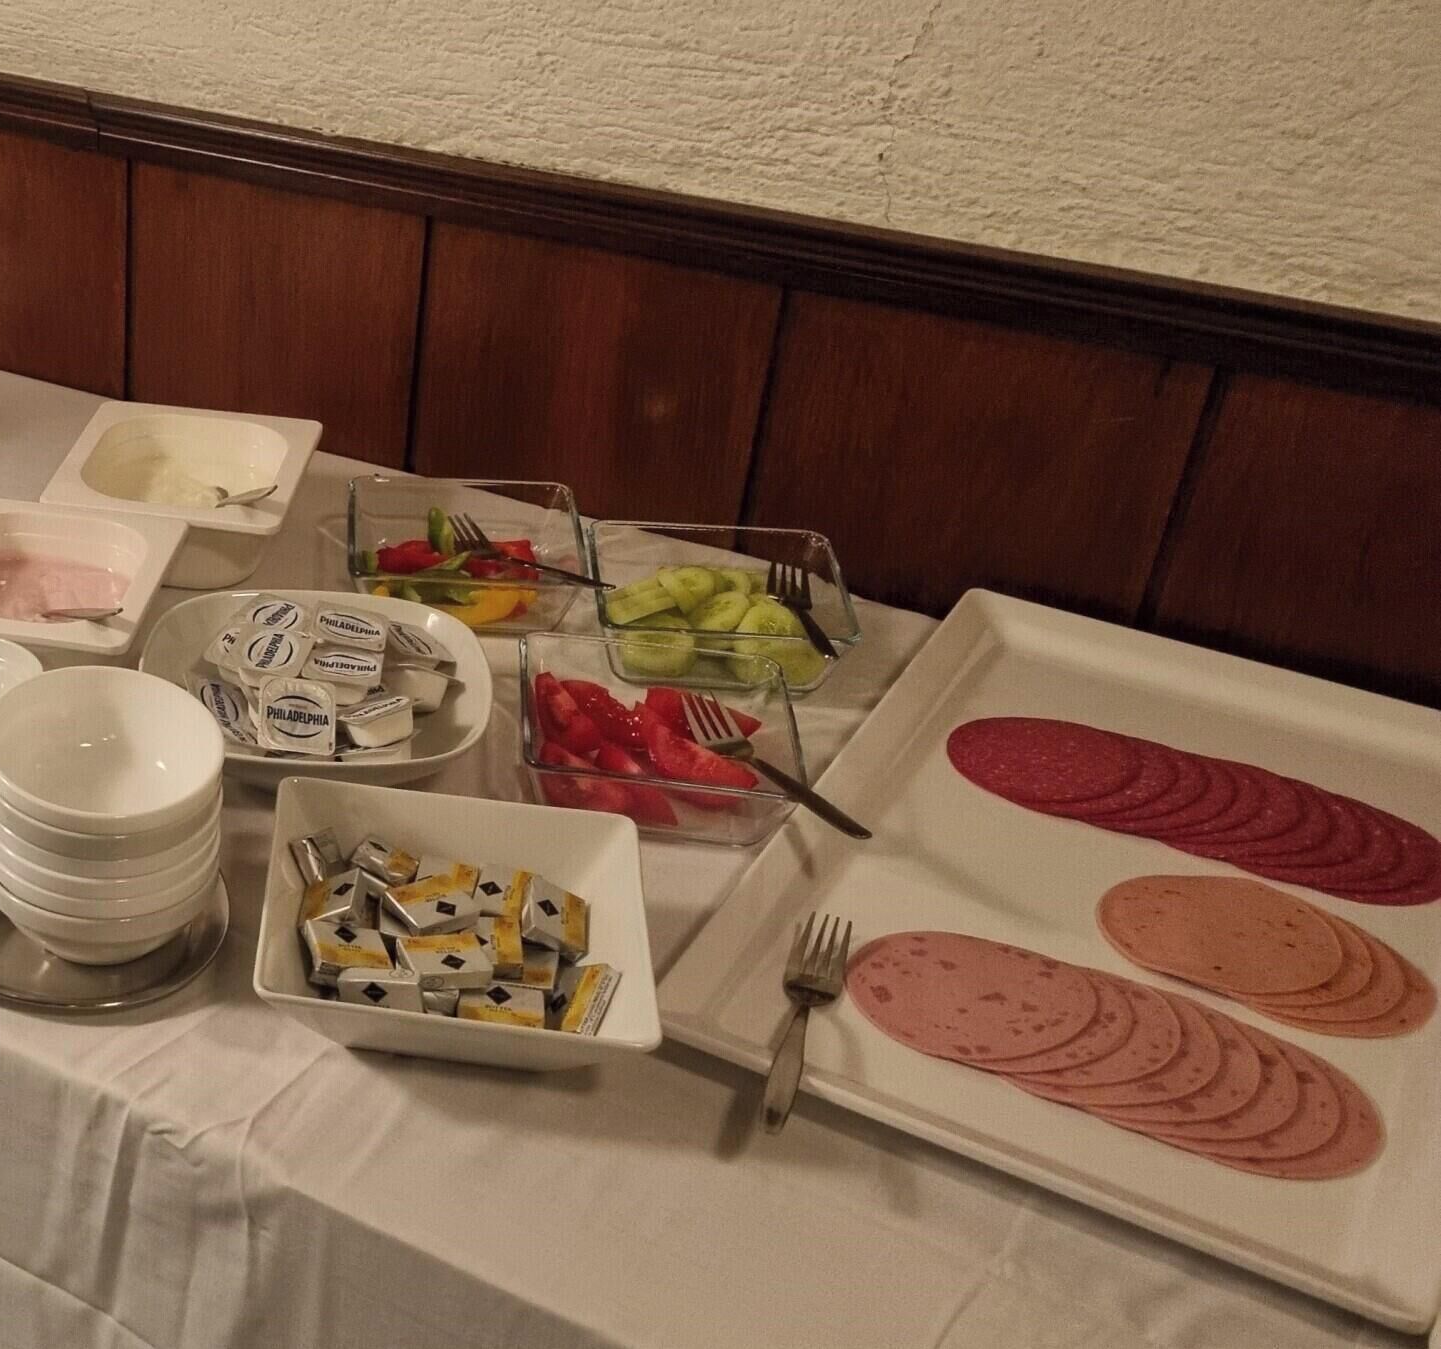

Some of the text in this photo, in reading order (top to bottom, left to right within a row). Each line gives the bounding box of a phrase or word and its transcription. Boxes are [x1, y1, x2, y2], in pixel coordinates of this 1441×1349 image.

[320, 615, 380, 636] PHILADELPHIA
[255, 633, 285, 668] PHILADELPHIA
[314, 658, 377, 672] PHILADELPHIA
[266, 705, 329, 726] PHILADELPHIA
